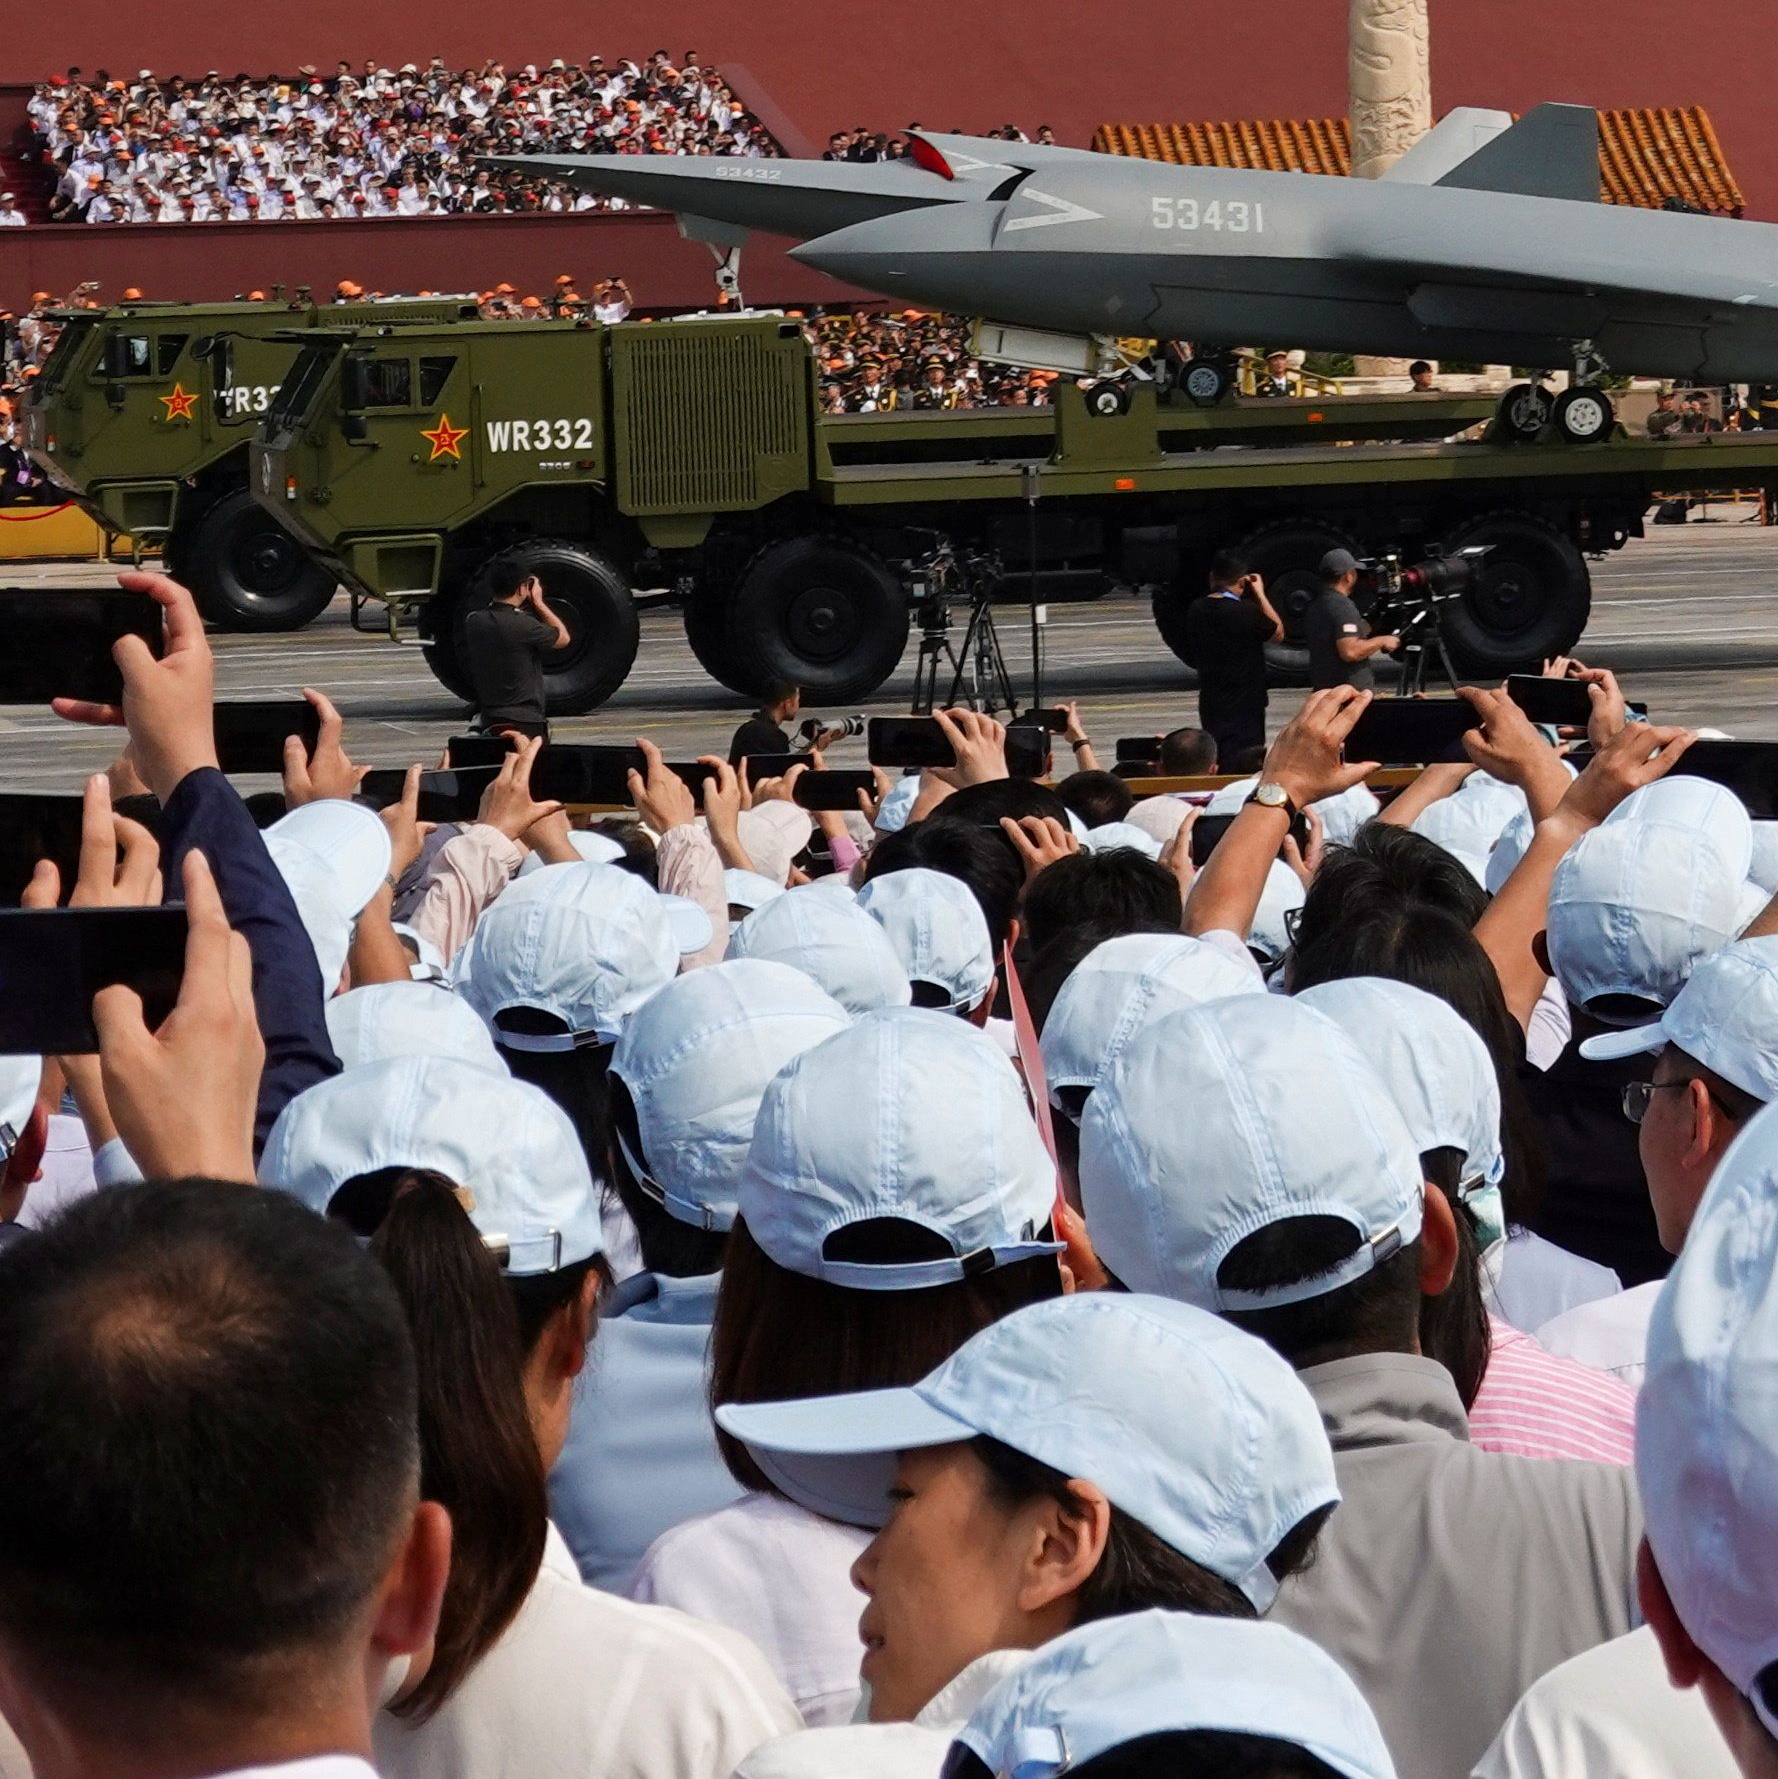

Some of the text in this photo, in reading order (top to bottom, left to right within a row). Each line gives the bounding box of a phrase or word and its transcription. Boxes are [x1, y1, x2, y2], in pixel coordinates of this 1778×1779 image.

[716, 166, 782, 180] 53432
[1152, 196, 1263, 233] 53431
[486, 418, 593, 453] WR332
